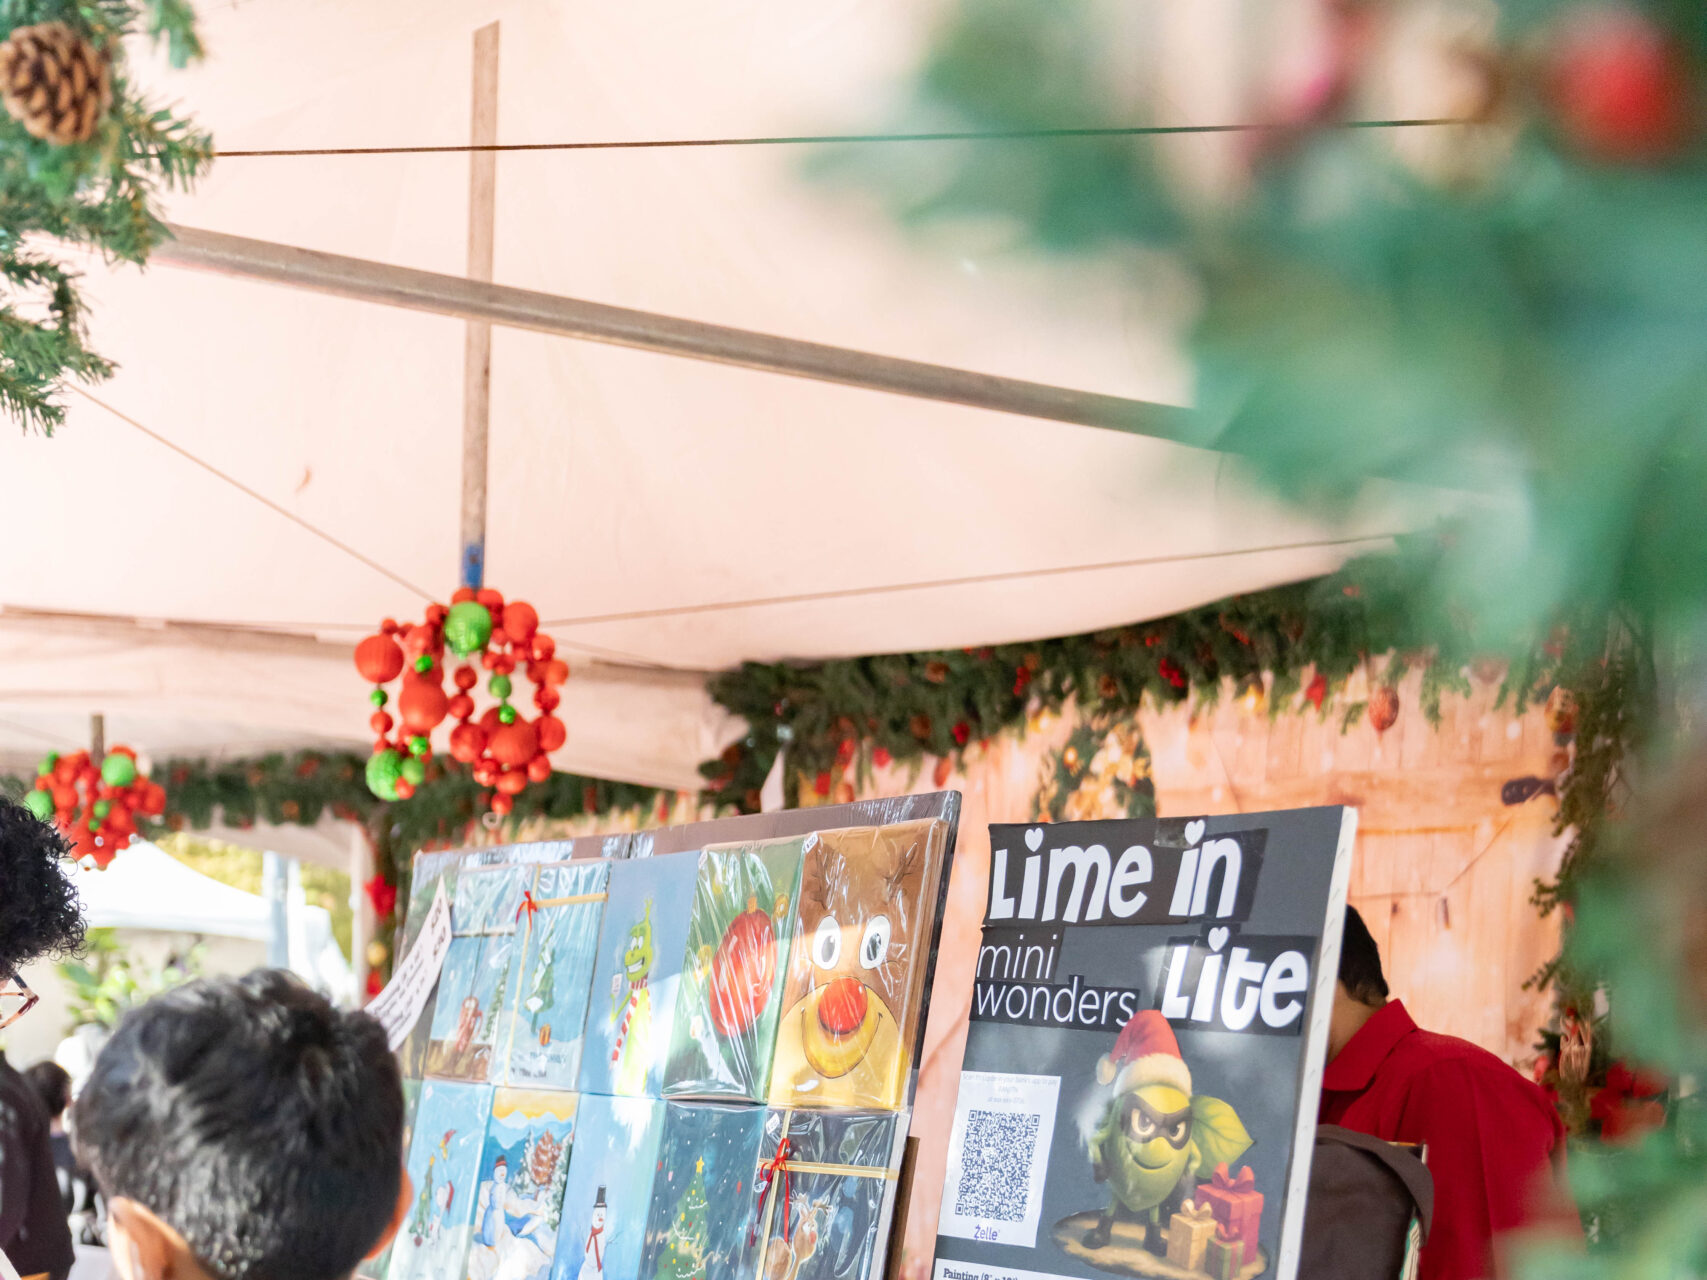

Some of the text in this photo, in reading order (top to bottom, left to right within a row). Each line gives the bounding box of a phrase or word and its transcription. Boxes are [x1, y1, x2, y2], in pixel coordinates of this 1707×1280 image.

[989, 820, 1243, 923] Lime in
[976, 934, 1058, 979] mini
[1161, 926, 1309, 1031] Lite
[976, 976, 1138, 1027] wonders
[974, 1224, 998, 1241] Zelle
